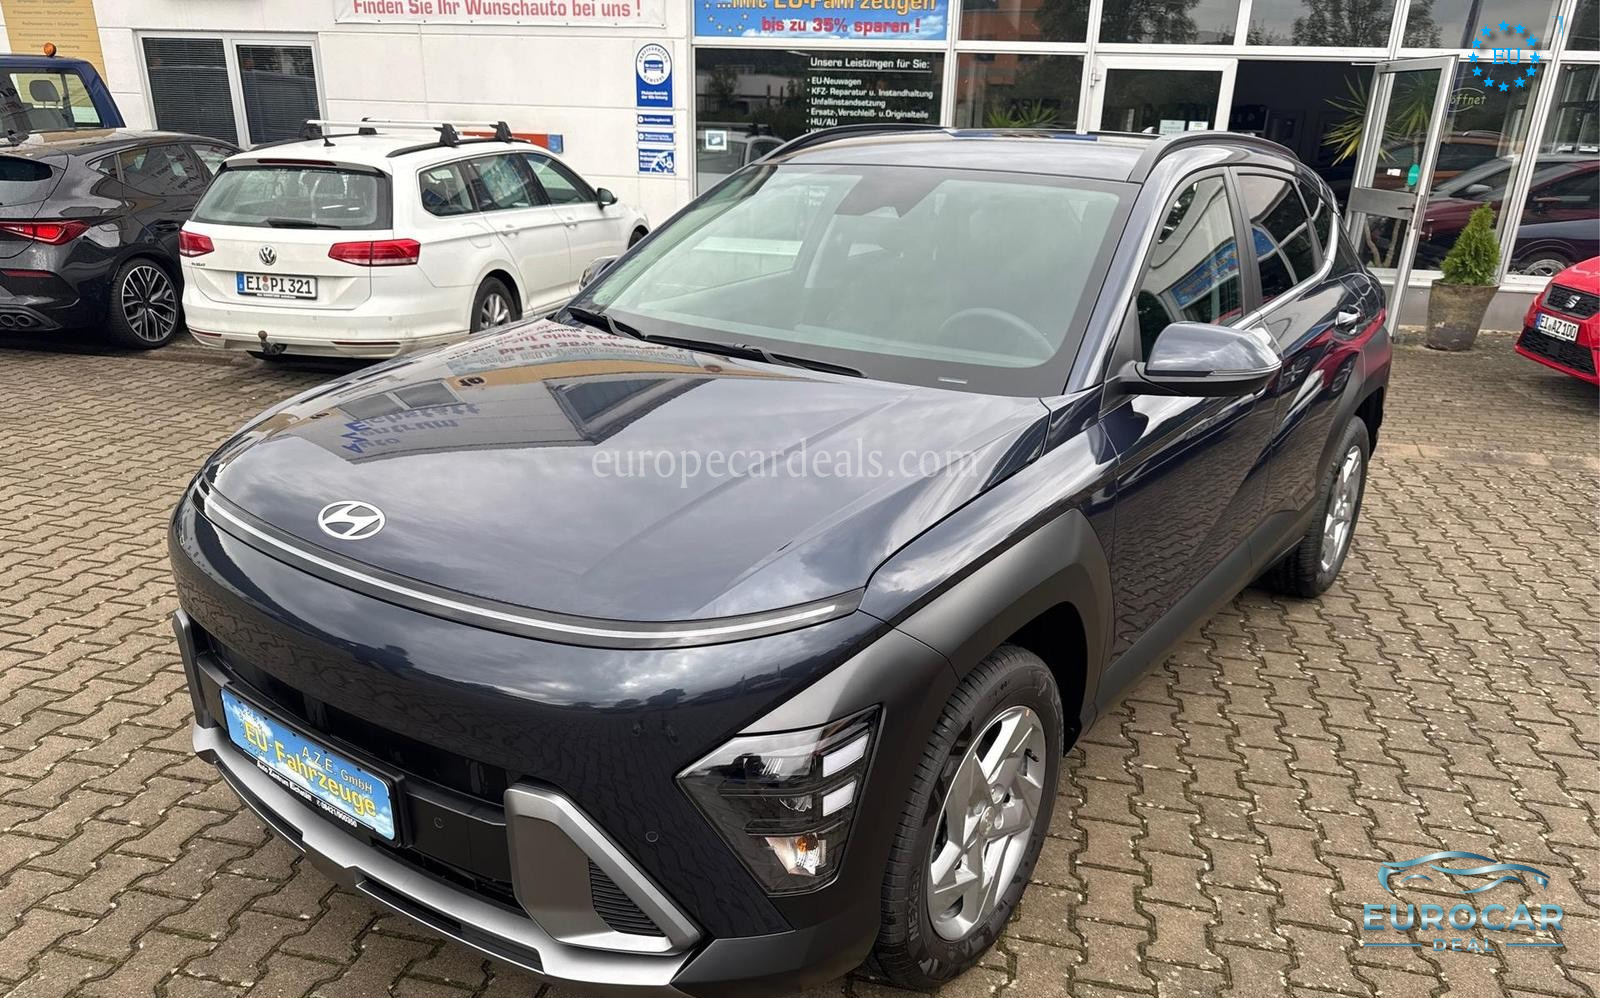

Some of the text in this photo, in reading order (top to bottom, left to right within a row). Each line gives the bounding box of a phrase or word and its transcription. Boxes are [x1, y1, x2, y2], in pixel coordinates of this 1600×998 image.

[353, 0, 404, 14] Finden
[408, 0, 433, 15] Sie
[437, 0, 460, 15] Ihr
[465, 0, 567, 16] Wunschauto
[572, 0, 596, 16] bei
[601, 2, 631, 17] uns
[761, 16, 785, 32] bis
[789, 20, 806, 32] zu
[812, 17, 848, 33] 35%
[853, 21, 910, 36] sparen
[810, 57, 930, 70] Unsere Leistungen für Sie:
[811, 76, 862, 87] EU-Neuwagen
[829, 88, 867, 98] Reparatur
[878, 89, 934, 99] Instandhaltung
[811, 97, 886, 108] Unfallinstandsetzung
[810, 118, 838, 126] HU/AU
[246, 275, 262, 291] EI
[340, 769, 373, 794] GmbH
